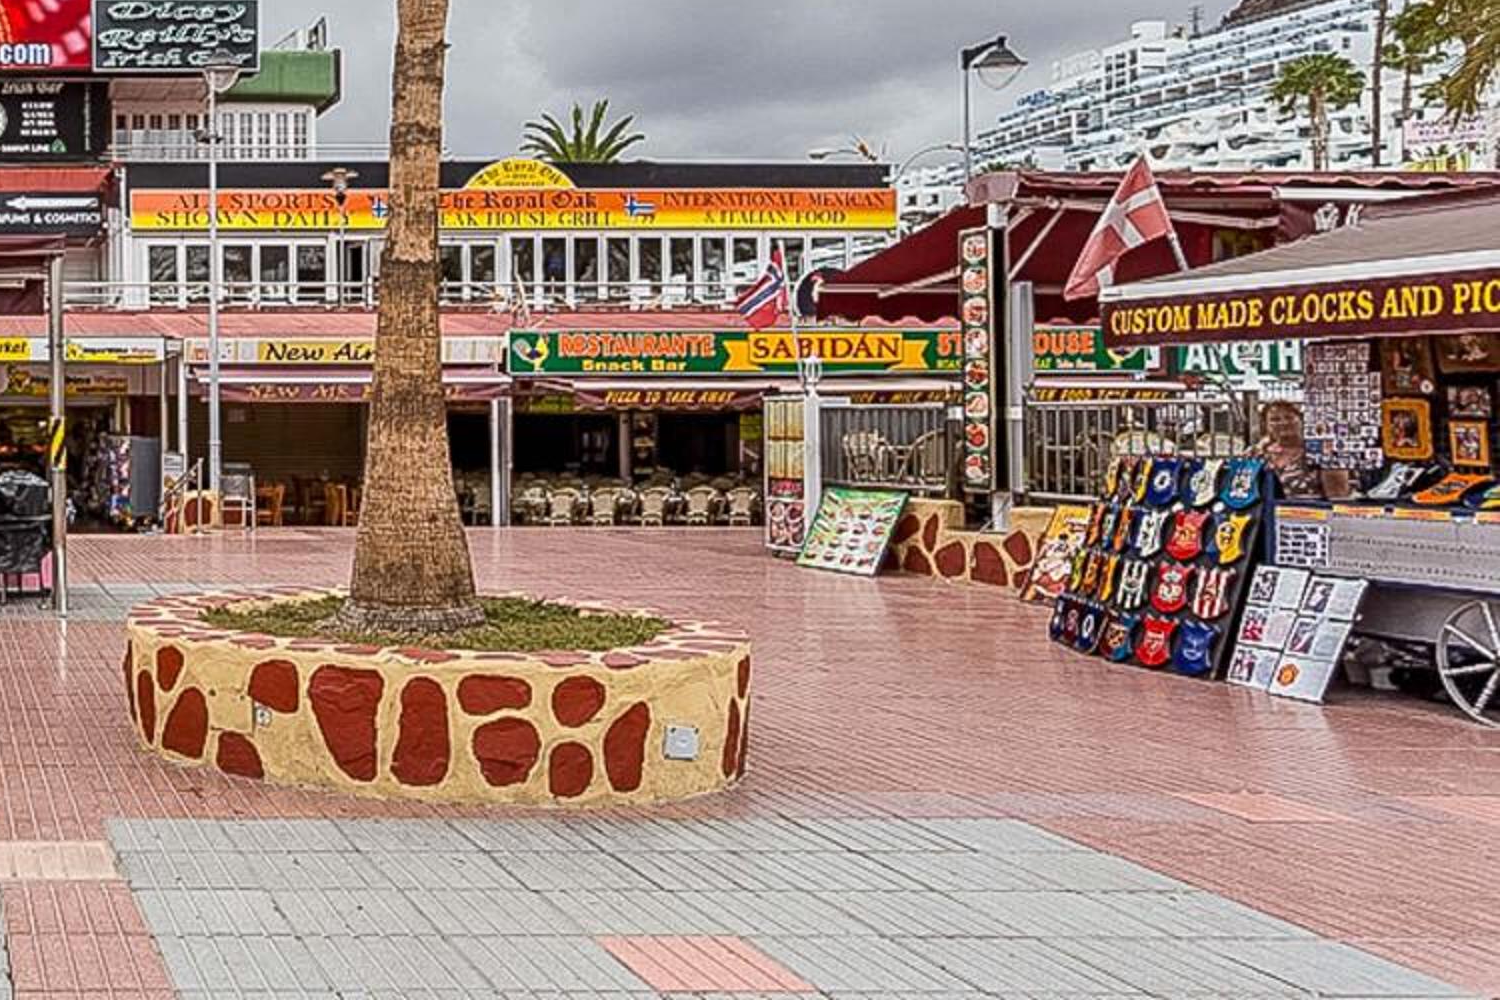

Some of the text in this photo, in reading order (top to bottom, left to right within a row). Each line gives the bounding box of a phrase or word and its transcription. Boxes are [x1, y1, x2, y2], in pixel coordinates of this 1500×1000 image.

[98, 24, 255, 50] Reilly's
[102, 48, 183, 67] Irish
[229, 192, 338, 210] SPORTS
[437, 190, 597, 211] The Royal Oak
[661, 191, 886, 208] INTERNATIONAL MEXICAN
[156, 210, 356, 227] SHOWN DAILY
[492, 210, 548, 227] HOUSE
[553, 210, 616, 227] GRILL
[720, 209, 789, 226] ITALIAN
[795, 209, 847, 225] FOOD
[1110, 304, 1192, 337] CUSTOM
[1196, 299, 1264, 330] MADE
[1269, 289, 1375, 325] CLOCKS
[1380, 283, 1445, 319] AND
[264, 342, 325, 362] New
[558, 331, 1095, 359] RESTAURANTE SABIDÁN OUSE
[581, 359, 646, 372] Snack
[651, 359, 687, 372] Bar
